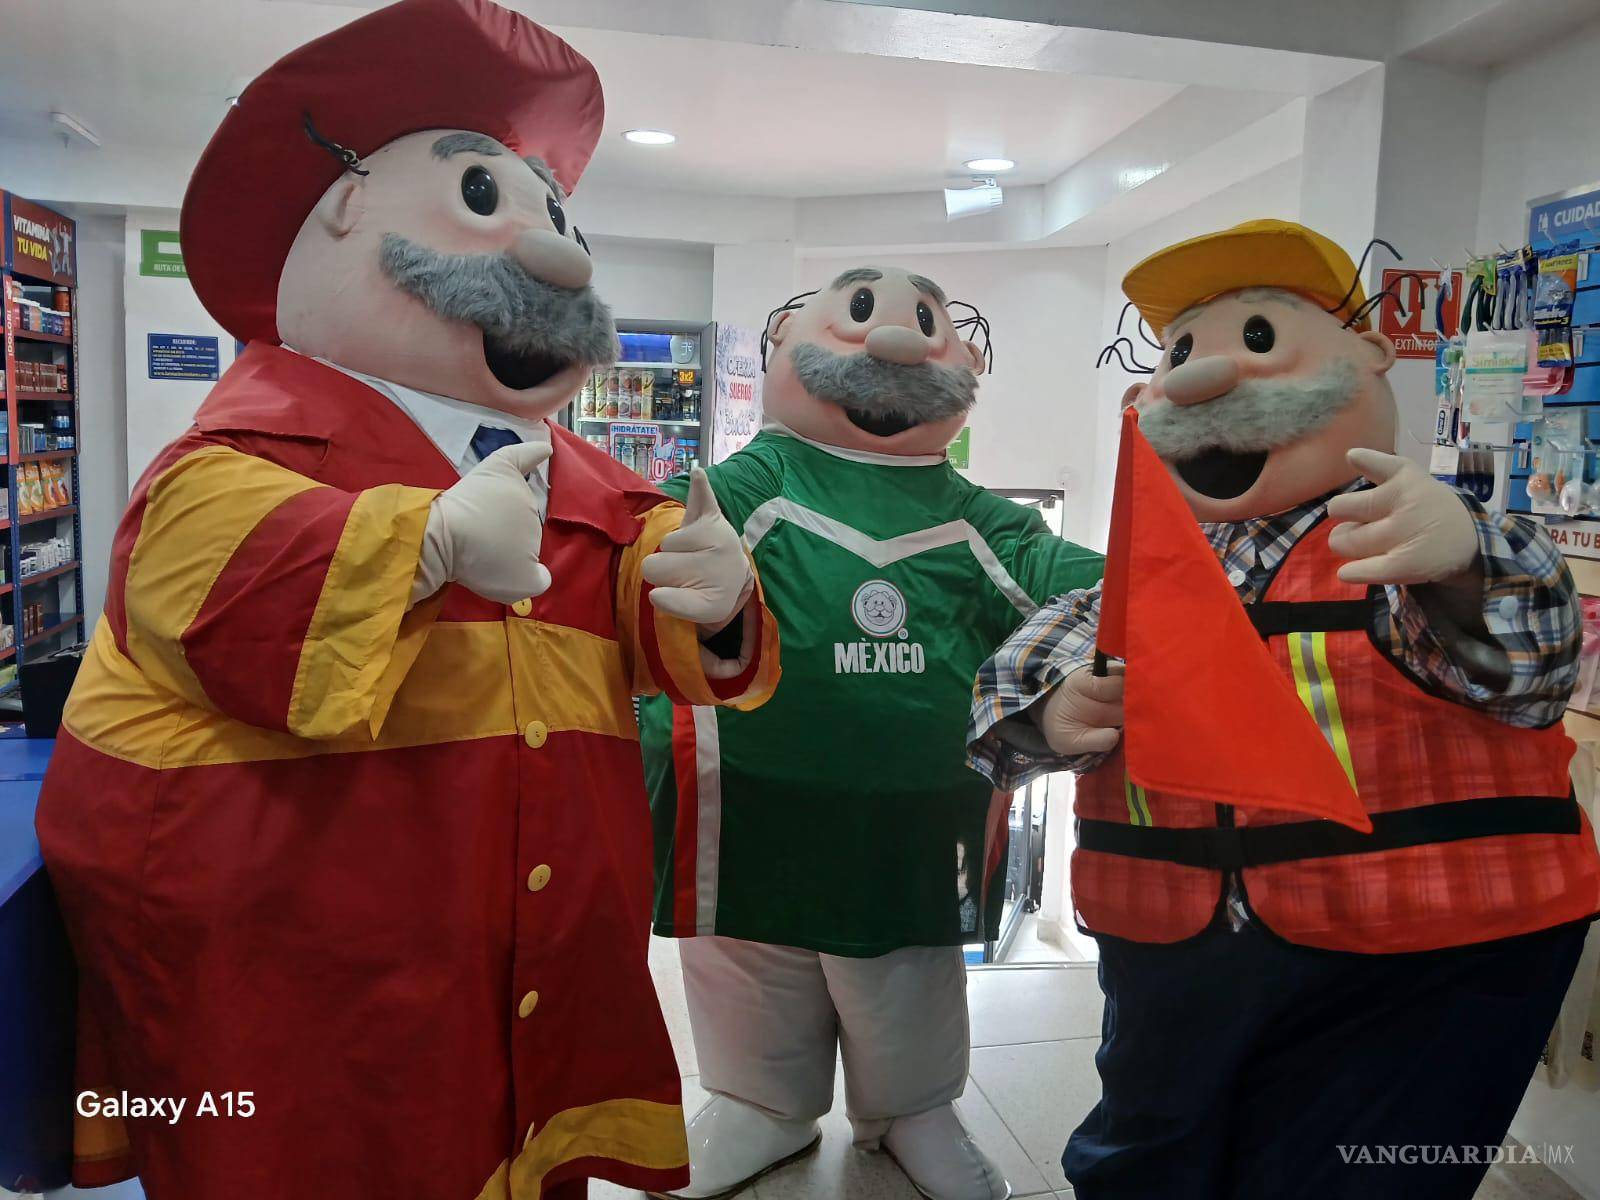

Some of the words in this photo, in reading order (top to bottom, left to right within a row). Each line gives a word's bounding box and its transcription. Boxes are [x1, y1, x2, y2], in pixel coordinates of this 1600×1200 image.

[17, 236, 29, 255] TU
[30, 241, 47, 262] VIDA
[1572, 531, 1591, 547] TU
